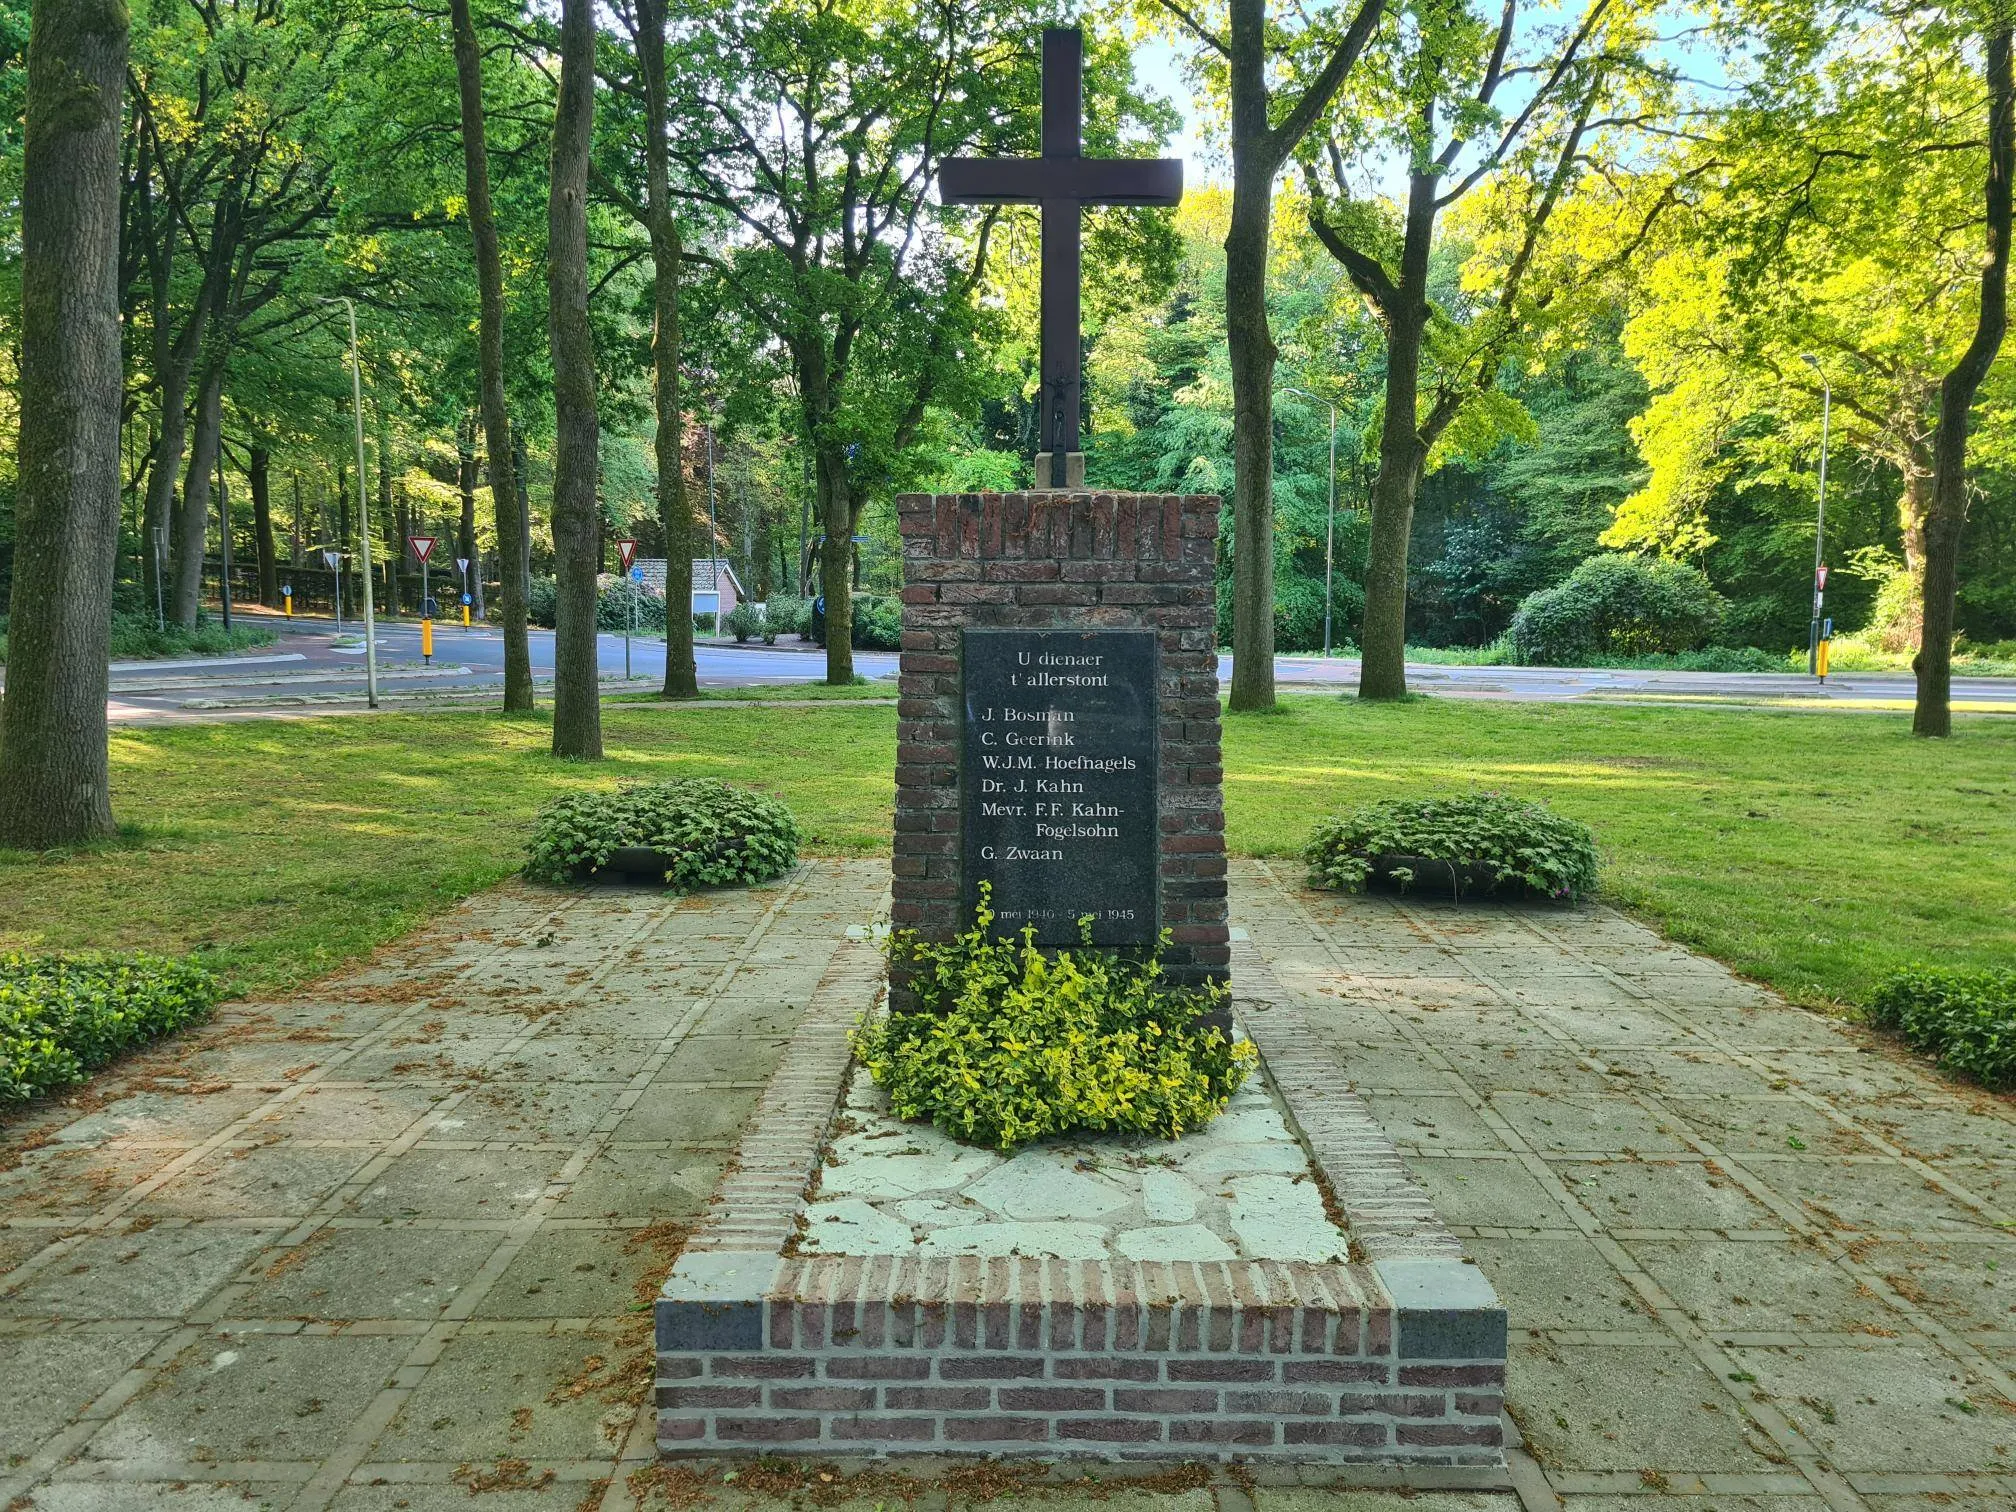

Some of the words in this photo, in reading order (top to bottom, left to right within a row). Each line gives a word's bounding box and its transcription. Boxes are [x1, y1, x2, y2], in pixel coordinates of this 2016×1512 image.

[1018, 652, 1030, 666] U
[1038, 651, 1103, 666] dienaer
[1027, 672, 1109, 687] allerstont
[981, 708, 995, 722] J.
[1004, 708, 1074, 722] Bosman
[981, 732, 998, 746] C.
[1005, 732, 1075, 746] Geerink
[982, 755, 1037, 769] W.J.M.
[1045, 755, 1136, 773] Hoefnagels
[982, 779, 1006, 793] Dr.
[1013, 779, 1028, 793] J.
[1036, 779, 1084, 793] Kahn
[981, 802, 1027, 816] Mevr.
[1035, 802, 1064, 816] F.F.
[1072, 802, 1125, 817] Kahn-
[1036, 823, 1119, 840] Fogelsohn
[981, 846, 998, 860] G.
[1006, 846, 1063, 860] Zwaan
[1067, 909, 1075, 919] 5
[1107, 909, 1135, 919] 1945
